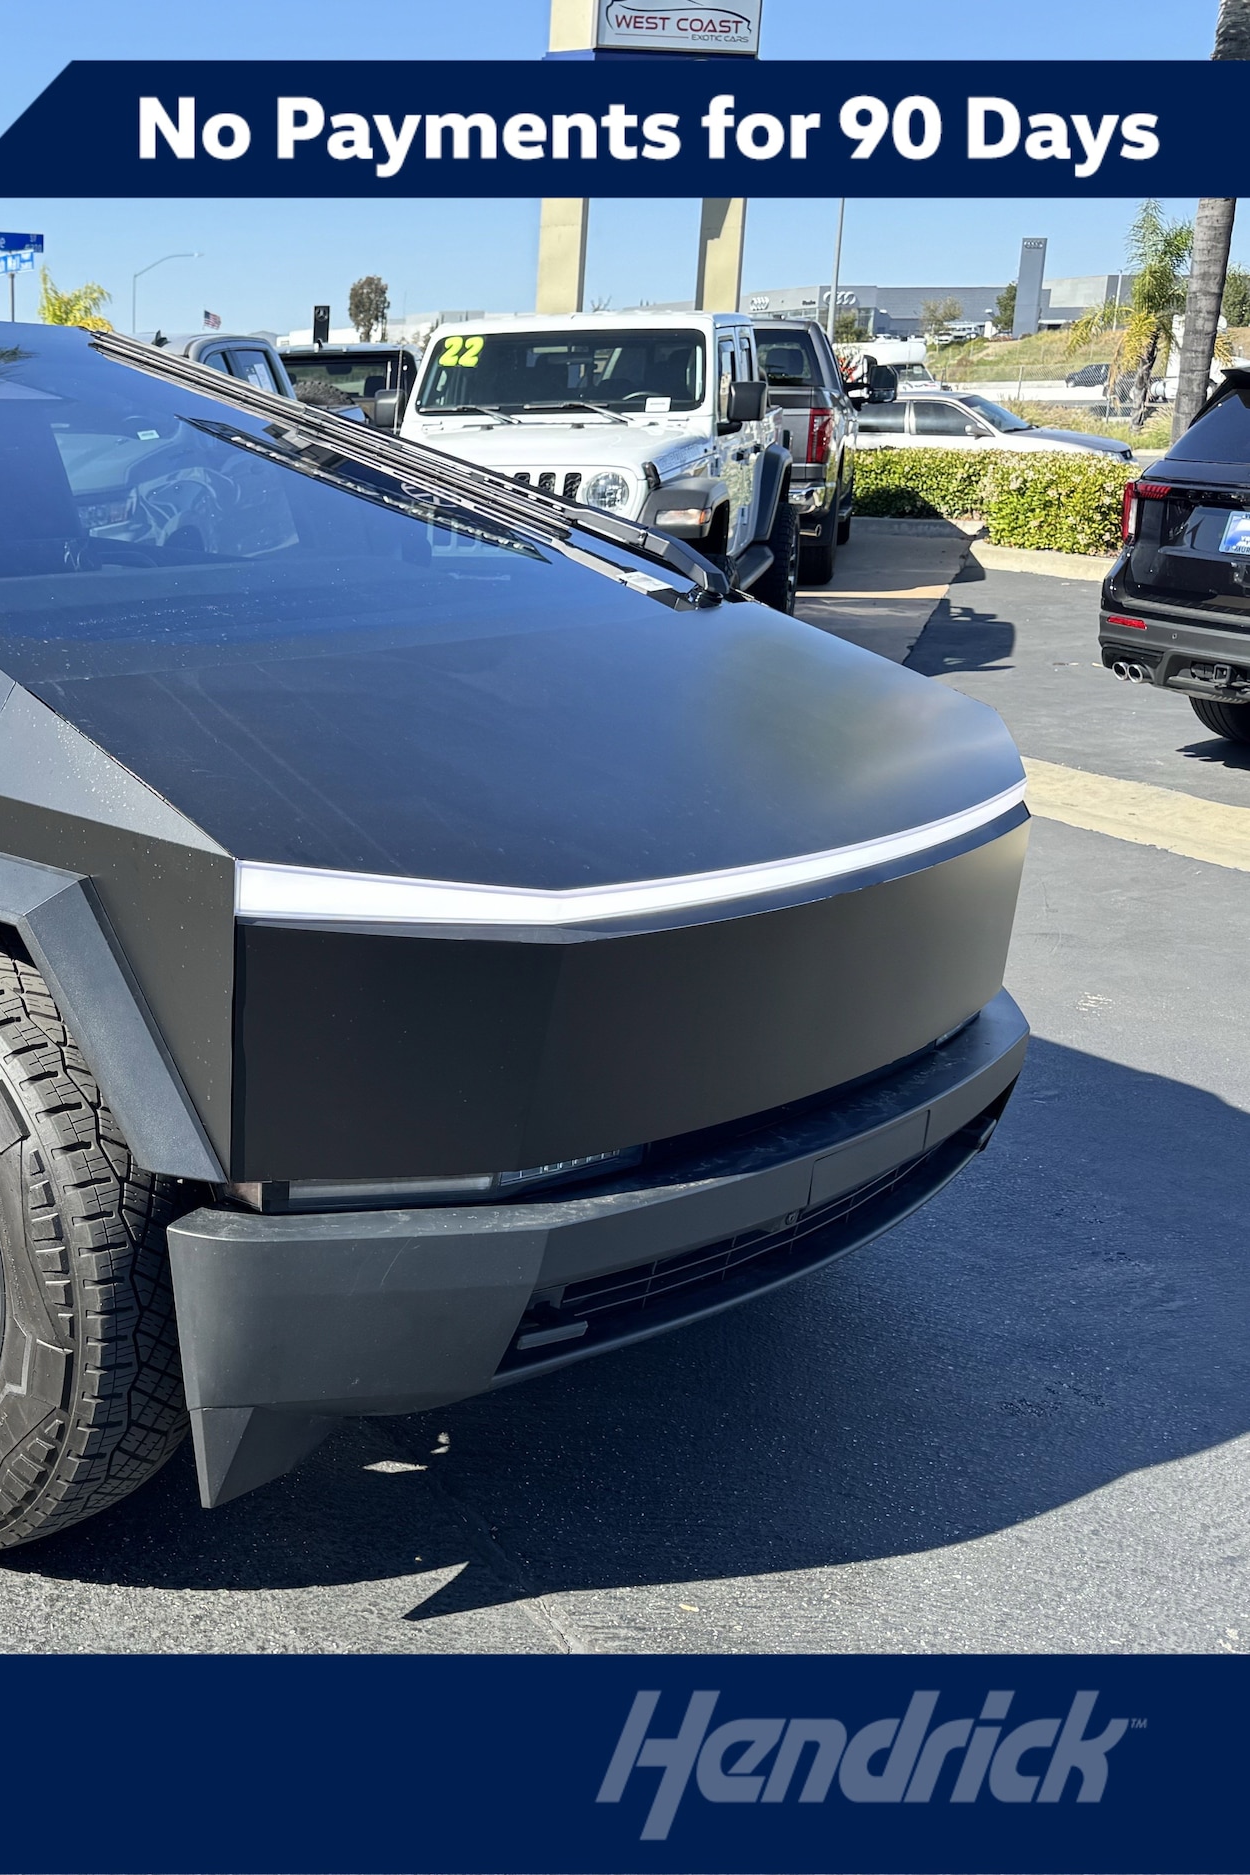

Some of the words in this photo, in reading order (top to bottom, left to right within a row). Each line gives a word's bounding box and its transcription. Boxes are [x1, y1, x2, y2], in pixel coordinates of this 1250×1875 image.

[615, 14, 670, 31] WEST
[676, 17, 743, 34] COAST
[691, 34, 722, 42] EXOTIC
[724, 34, 749, 43] CARS
[438, 335, 485, 367] 22
